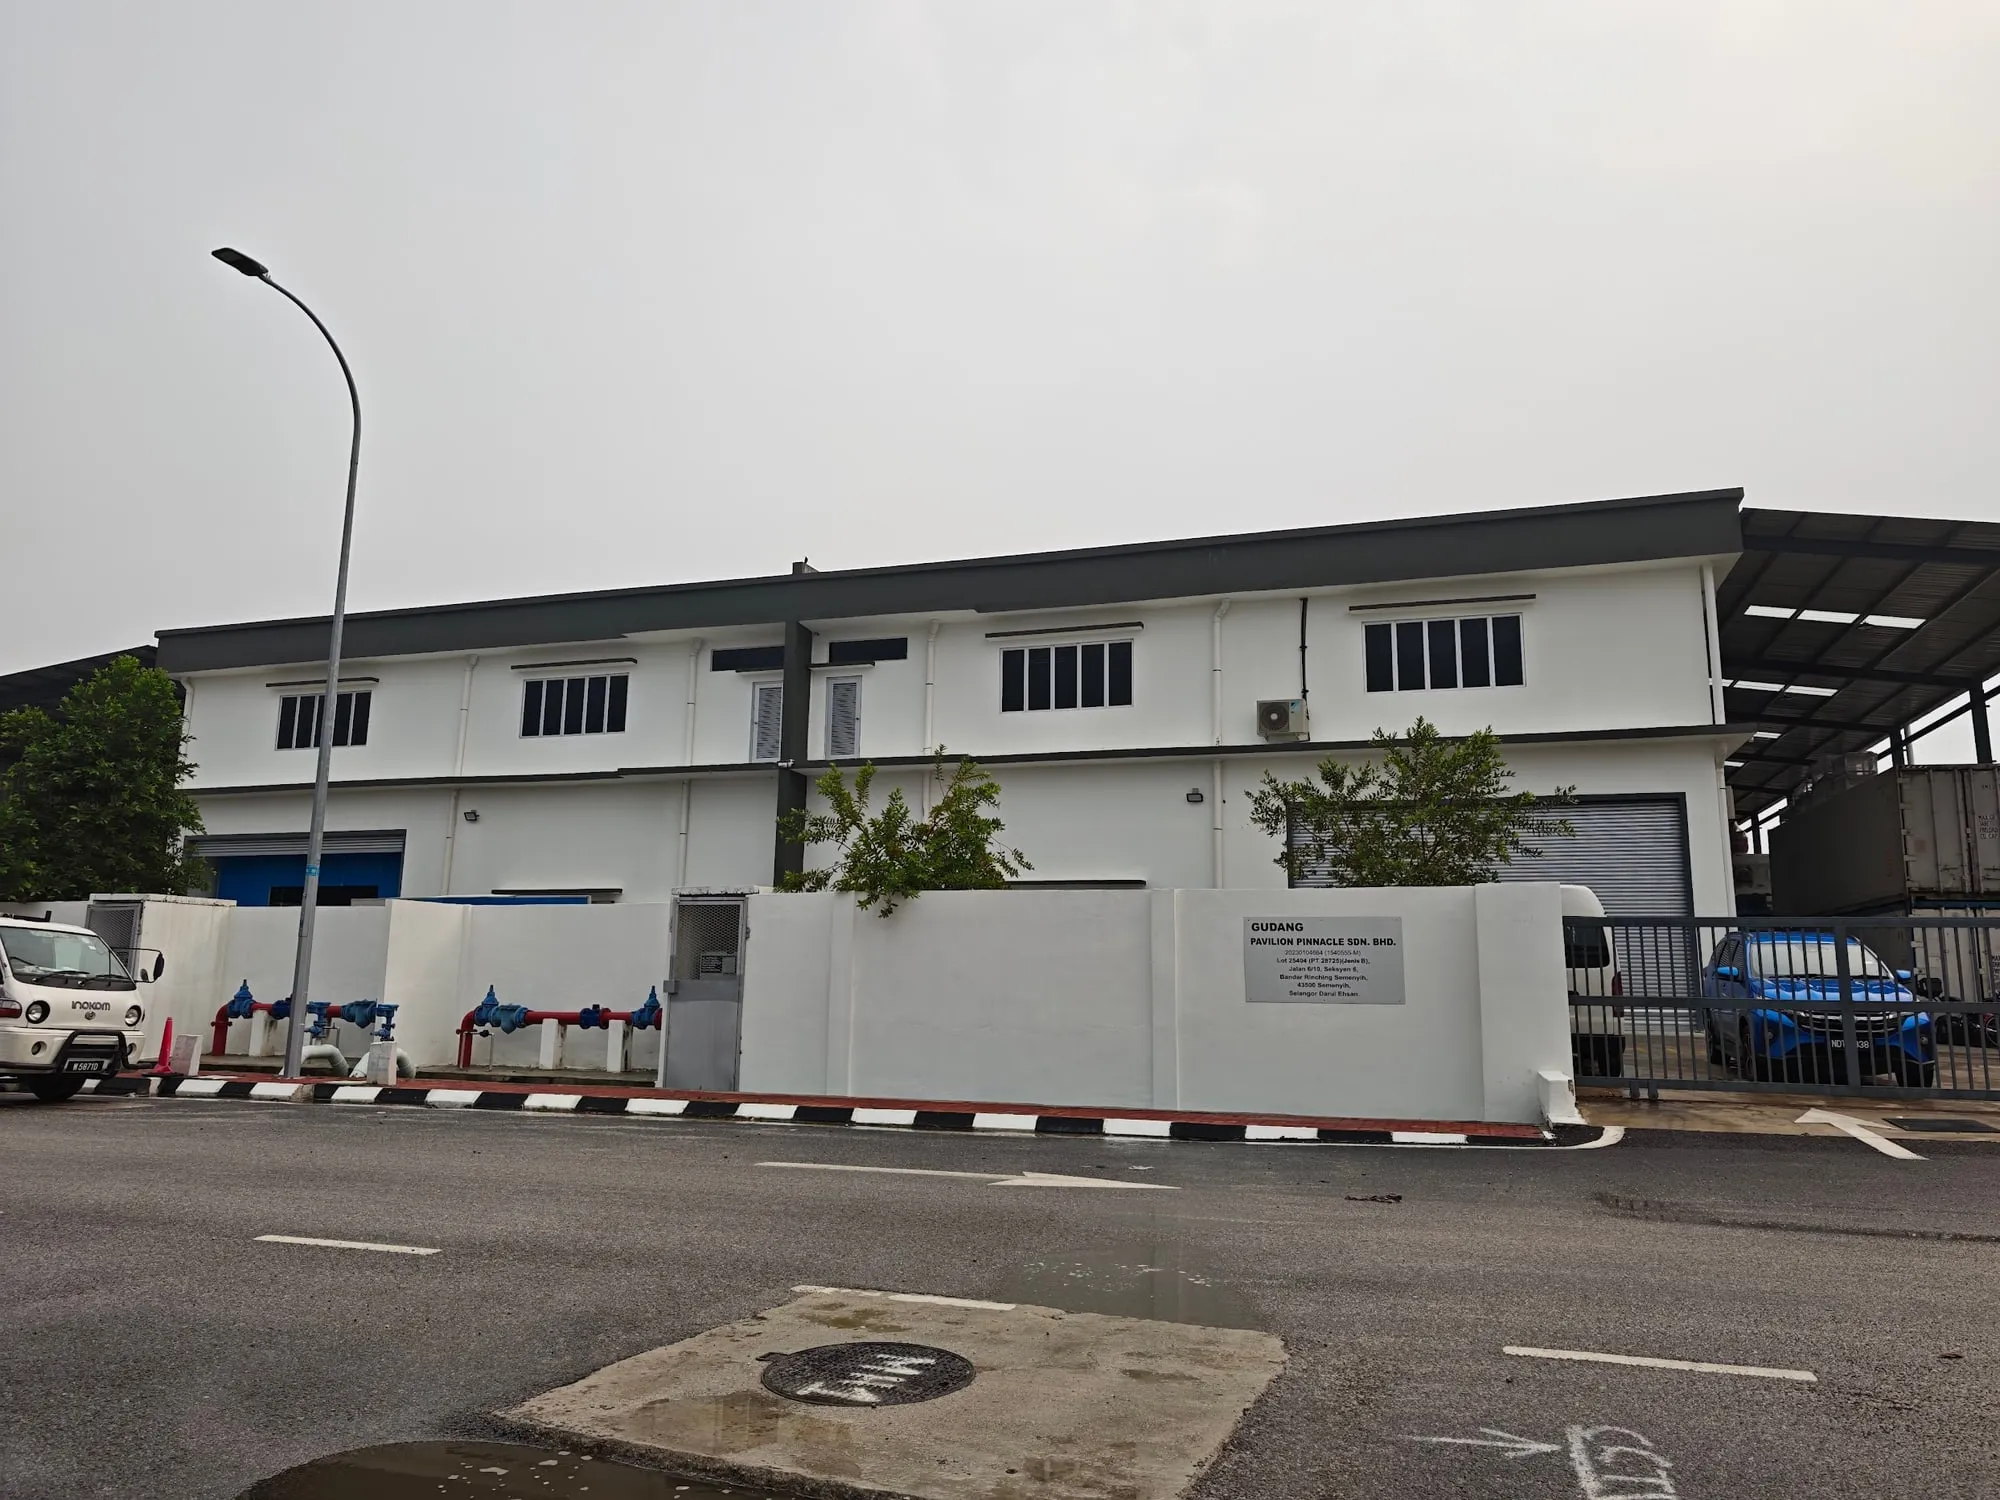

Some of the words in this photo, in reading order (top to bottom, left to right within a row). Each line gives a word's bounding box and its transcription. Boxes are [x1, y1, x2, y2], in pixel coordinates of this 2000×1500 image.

[1251, 922, 1304, 932] GUDANG
[1250, 937, 1294, 946] PAVILION
[1296, 937, 1345, 946] PINNACLE
[1347, 938, 1370, 946] SDN.
[1372, 938, 1396, 946] BHD.
